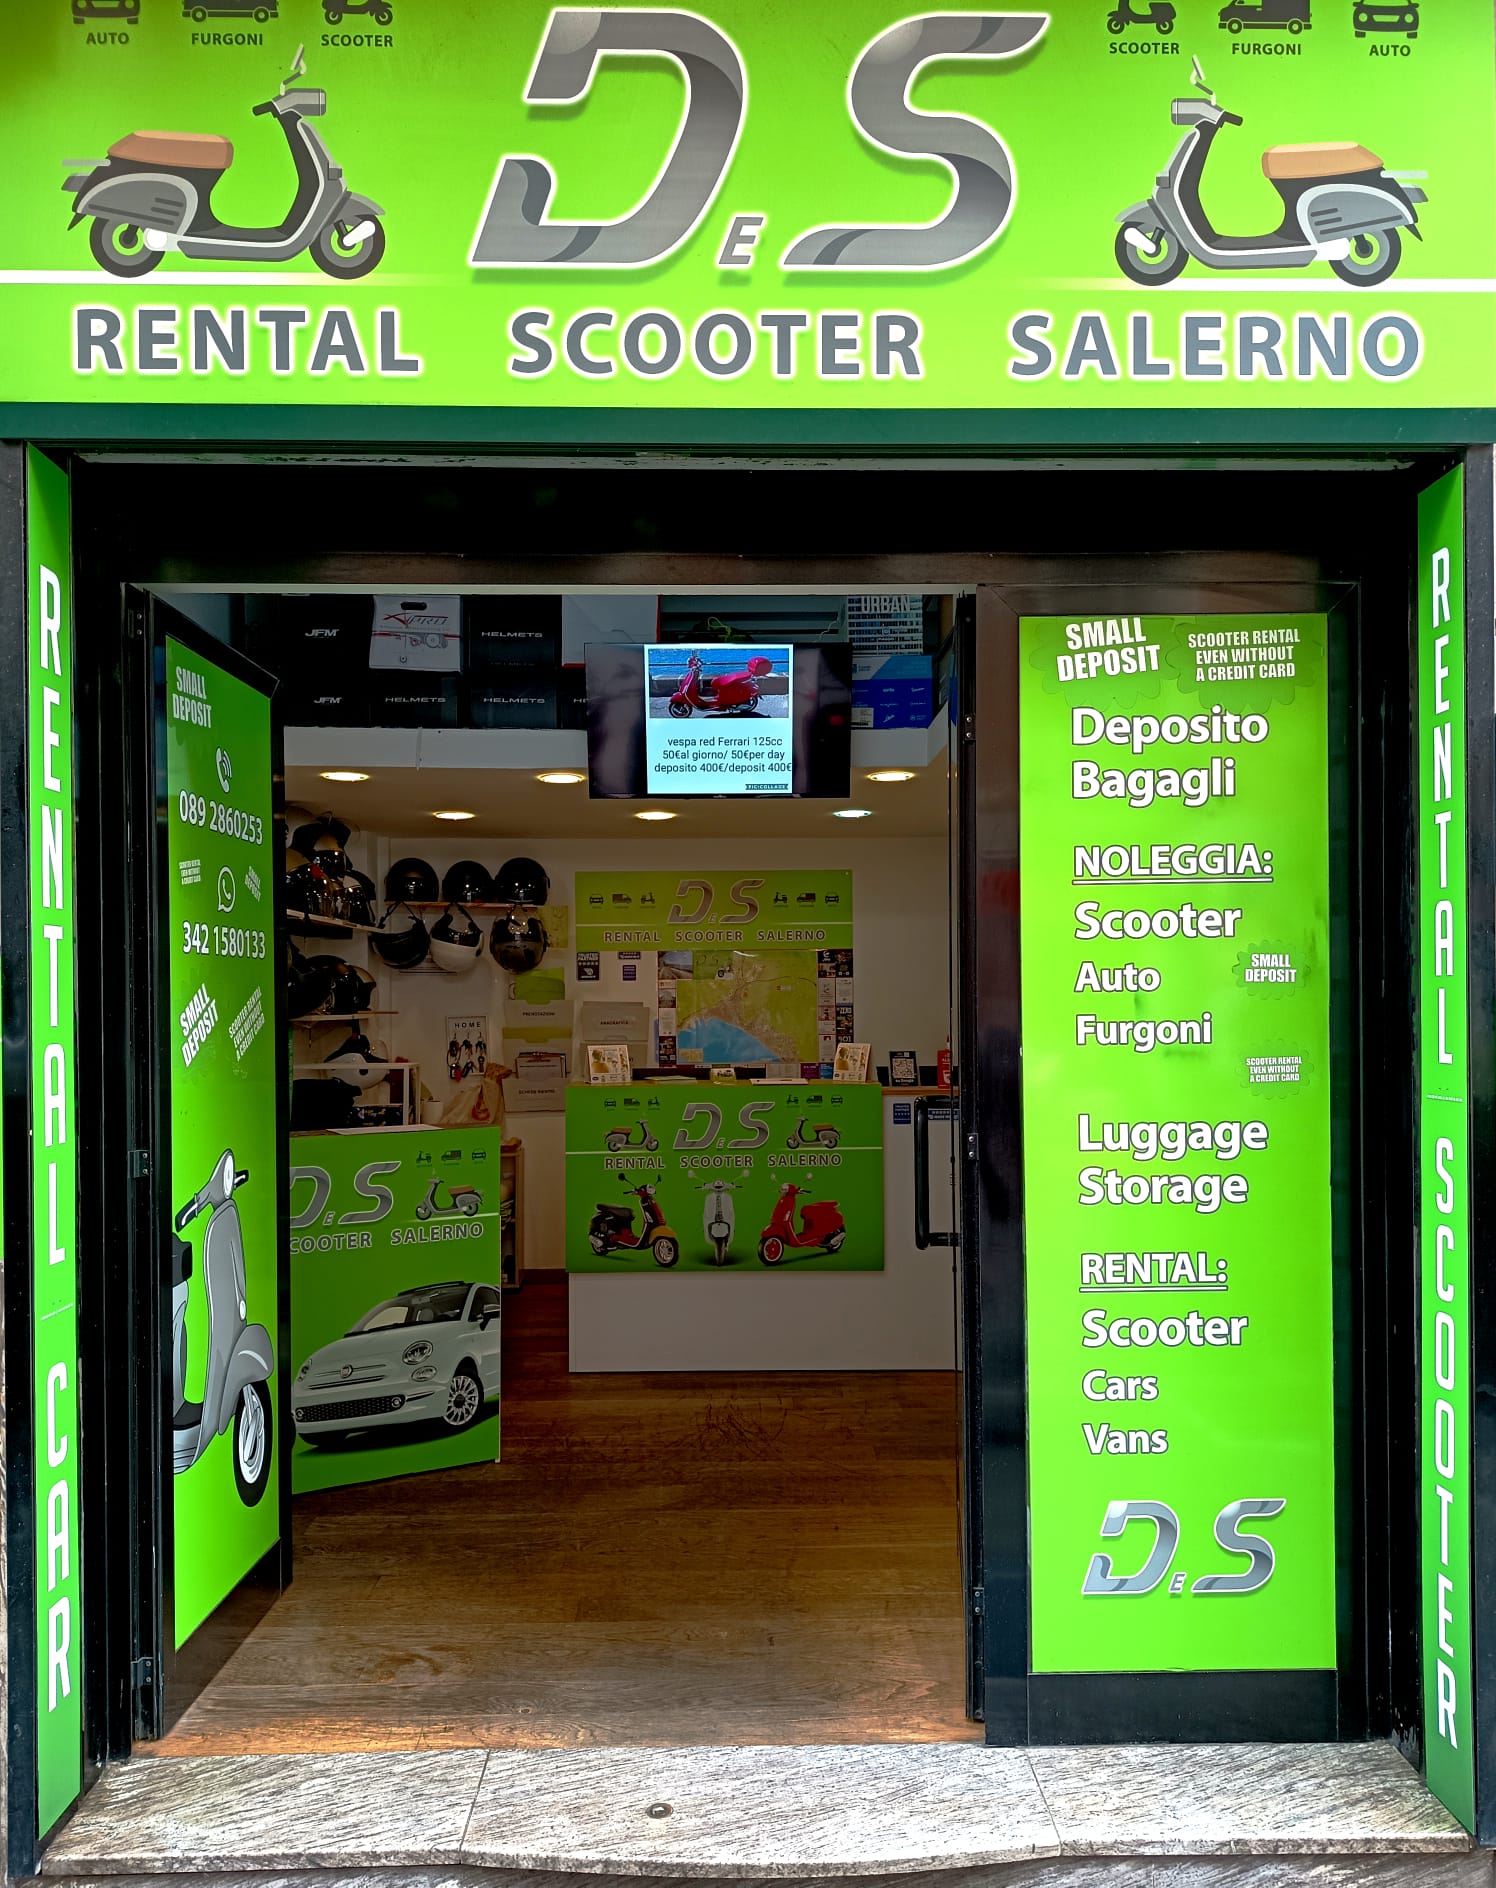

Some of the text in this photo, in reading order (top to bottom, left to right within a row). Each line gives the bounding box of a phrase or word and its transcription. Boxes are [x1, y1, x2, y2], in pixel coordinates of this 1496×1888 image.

[86, 32, 129, 45] AUTO
[191, 32, 263, 46] FURGONI
[320, 34, 393, 48] SCOOTER
[1109, 41, 1180, 55] SCOOTER
[1231, 43, 1302, 56] FURGONI
[1369, 44, 1411, 57] AUTO
[74, 308, 1421, 378] RENTAL SCOOTER SALERNO
[861, 595, 911, 613] URBAN
[305, 629, 339, 637] JFM
[1065, 616, 1147, 651] SMALL
[1188, 628, 1301, 648] SCOOTER RENTAL
[1057, 644, 1160, 682] DEPOSIT
[1195, 646, 1294, 665] EVEN WITHOUT
[176, 666, 207, 700] SMALL
[1195, 662, 1295, 682] A CREDIT CARD
[172, 693, 212, 729] DEPOSIT
[667, 737, 783, 748] vespa red Ferrari 125cc
[1071, 704, 1269, 754] Deposito
[654, 763, 698, 774] deposito
[768, 763, 792, 772] 400€
[662, 750, 785, 761] 50€al giorno/ 50€per day
[1071, 757, 1236, 808] Bagagli
[179, 789, 263, 845] 089 2860253
[1431, 546, 1454, 1066] RENTAL
[1073, 843, 1273, 877] NOLEGGIA:
[1073, 900, 1243, 940] Scooter
[182, 921, 266, 959] 342 1580133
[604, 929, 826, 943] RENTAL SCOOTER SALERNO
[1245, 968, 1297, 983] DEPOSIT
[1251, 953, 1291, 968] SMALL
[1073, 961, 1161, 992] Auto
[180, 983, 211, 1037] SMALL
[182, 998, 219, 1068] DEPOSIT
[1075, 1012, 1212, 1053] Furgoni
[1246, 1056, 1302, 1066] SCOOTER RENTAL
[1250, 1064, 1299, 1074] EVEN WITHOUT
[1256, 1073, 1280, 1083] CREDIT
[1281, 1073, 1300, 1082] CARD
[39, 564, 71, 1714] RENTAL CAR
[1078, 1113, 1269, 1161] Luggage
[604, 1153, 842, 1170] RENTAL SCOOTER SALERNO
[1078, 1166, 1248, 1214] Storage
[391, 1222, 484, 1245] SALERNO
[1081, 1252, 1228, 1285] RENTAL:
[1082, 1308, 1248, 1348] Scooter
[1082, 1369, 1159, 1401] Cars
[1081, 1423, 1168, 1455] Vans
[1434, 1137, 1458, 1752] SCOOTER
